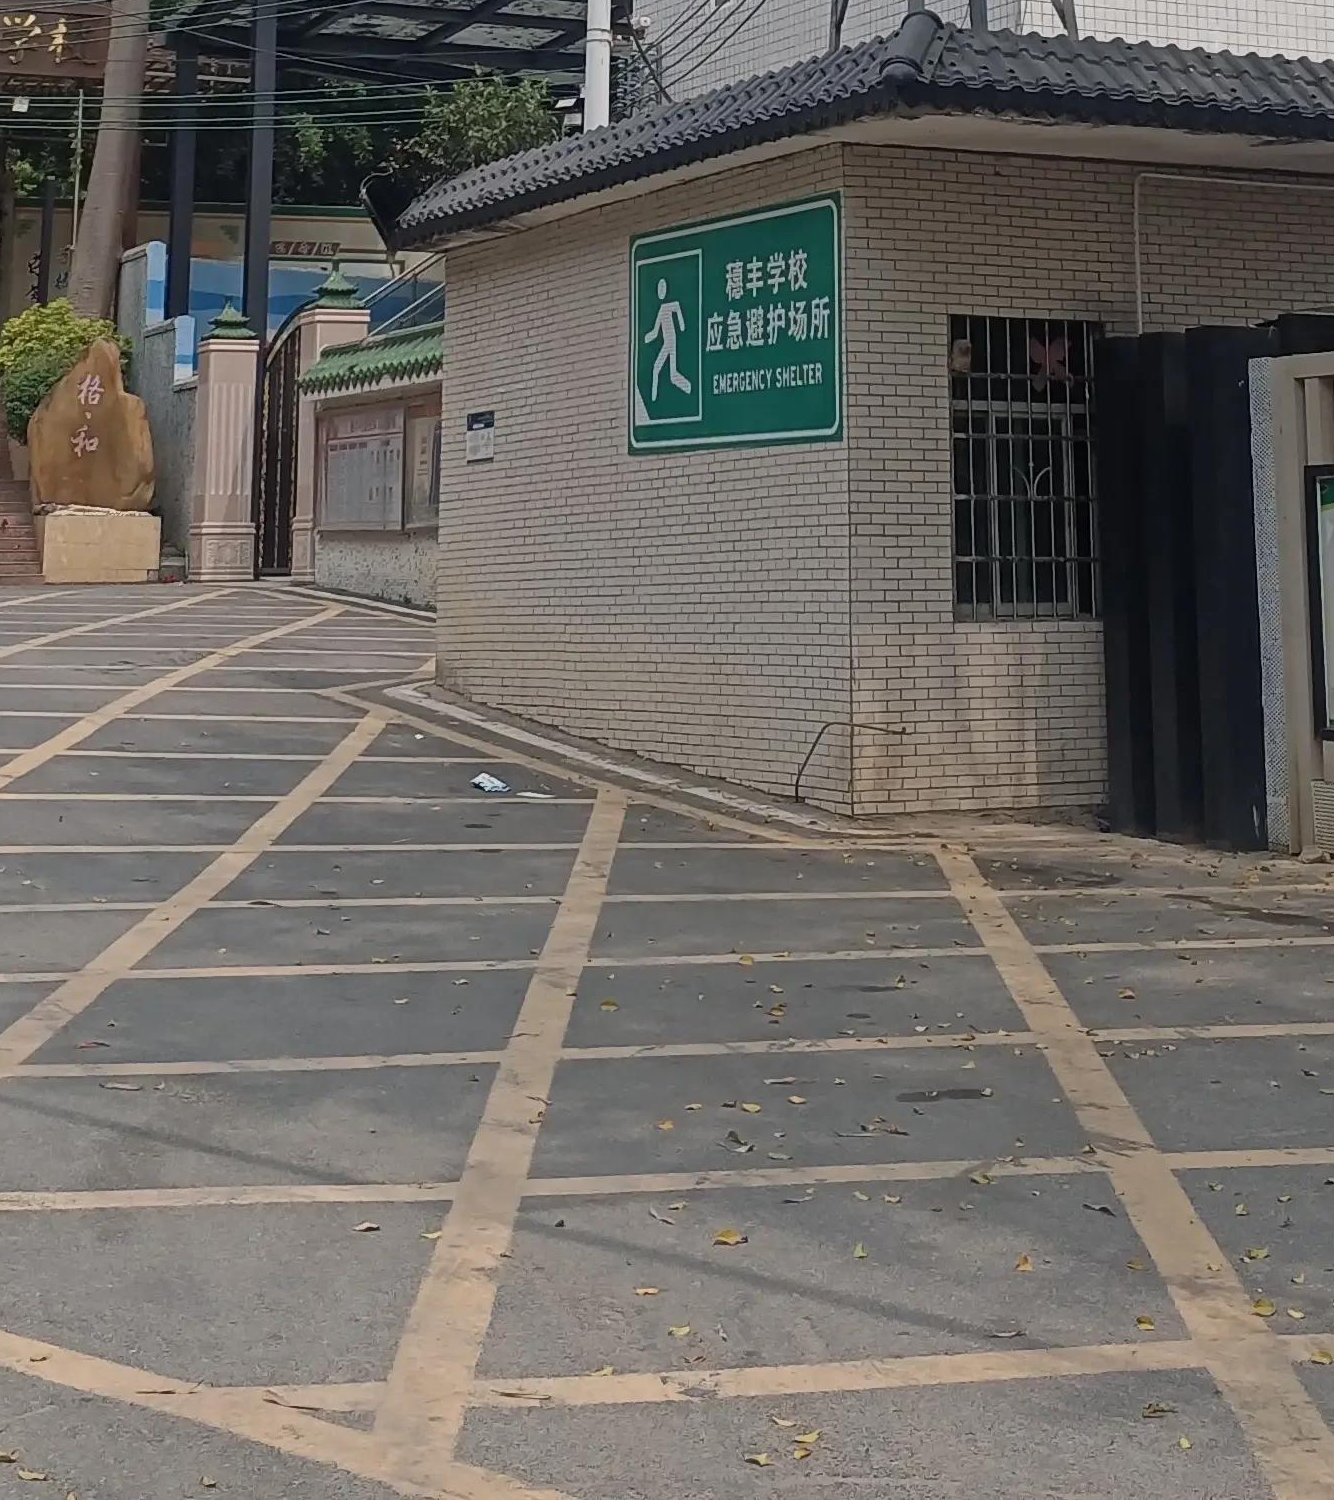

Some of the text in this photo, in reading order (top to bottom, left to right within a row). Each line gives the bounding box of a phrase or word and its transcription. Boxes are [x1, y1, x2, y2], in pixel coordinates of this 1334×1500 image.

[726, 249, 808, 302] 穗丰学校
[706, 296, 831, 352] 应急避护场所
[713, 363, 822, 394] EMERGENCY SHELTER
